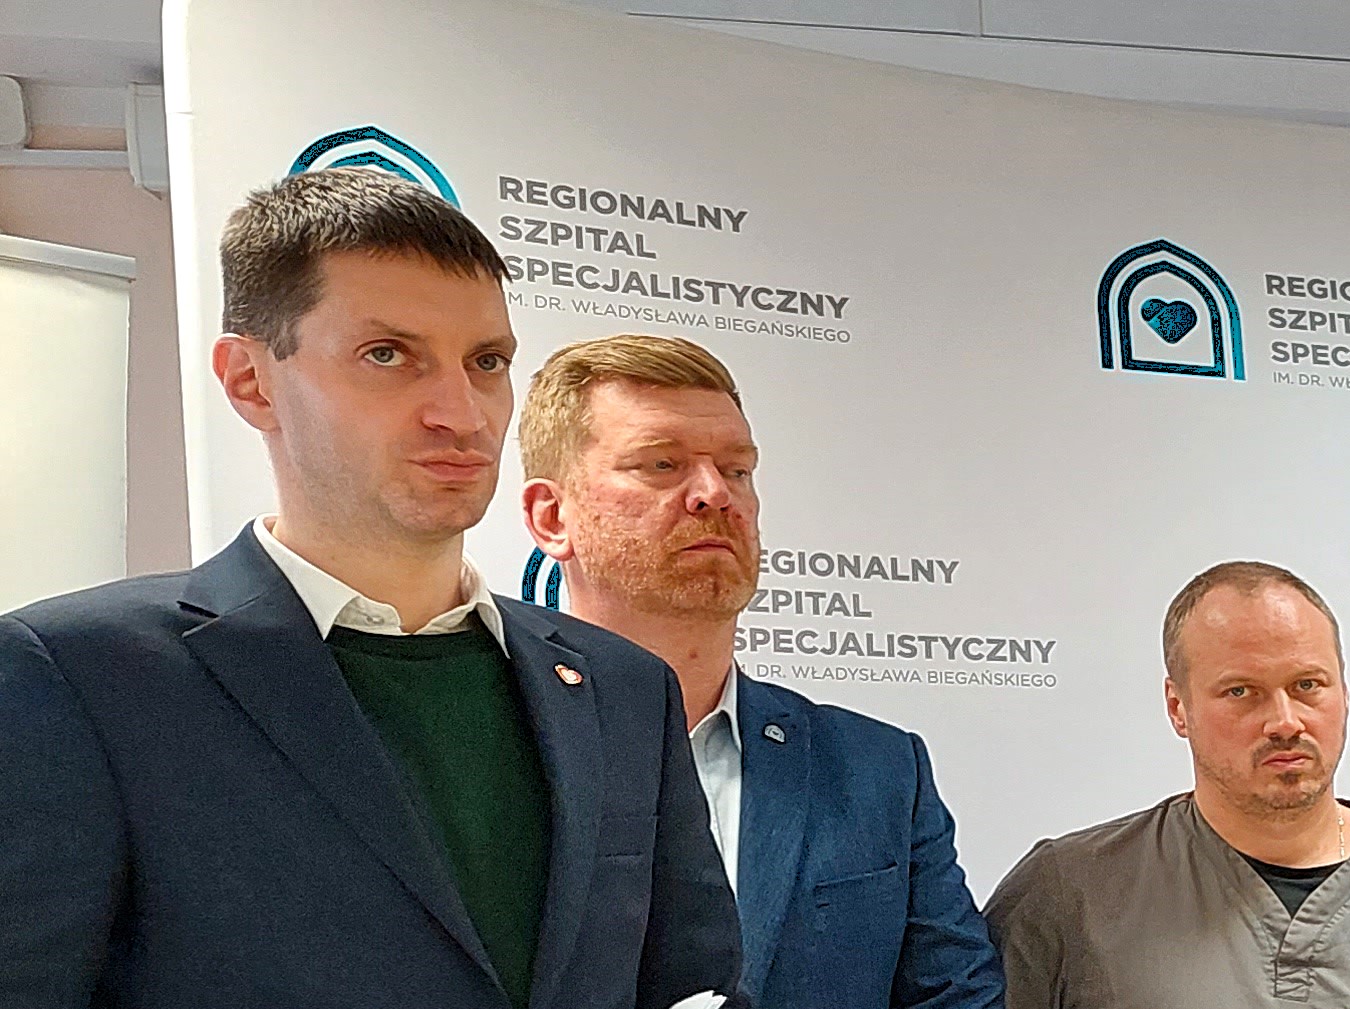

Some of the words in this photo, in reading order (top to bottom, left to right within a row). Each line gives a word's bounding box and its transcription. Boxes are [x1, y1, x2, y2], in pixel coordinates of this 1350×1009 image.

[499, 176, 748, 233] REGIONALNY
[499, 216, 657, 259] SZPITAL
[503, 255, 850, 320] SPECJALISTYCZNY
[508, 292, 528, 307] M.
[534, 294, 566, 311] DR.
[572, 299, 709, 328] WŁADYSŁAWA
[714, 316, 851, 343] BIEGAŃSKIEGO
[1273, 371, 1294, 385] IM.
[1298, 373, 1325, 387] DR.
[748, 588, 872, 618] ZPITAL
[733, 626, 1057, 664] SPECJALISTYCZNY
[756, 664, 787, 680] DR.
[792, 665, 922, 683] WŁADYSŁAWA
[927, 669, 1057, 688] BIEGAŃSKIEGO
